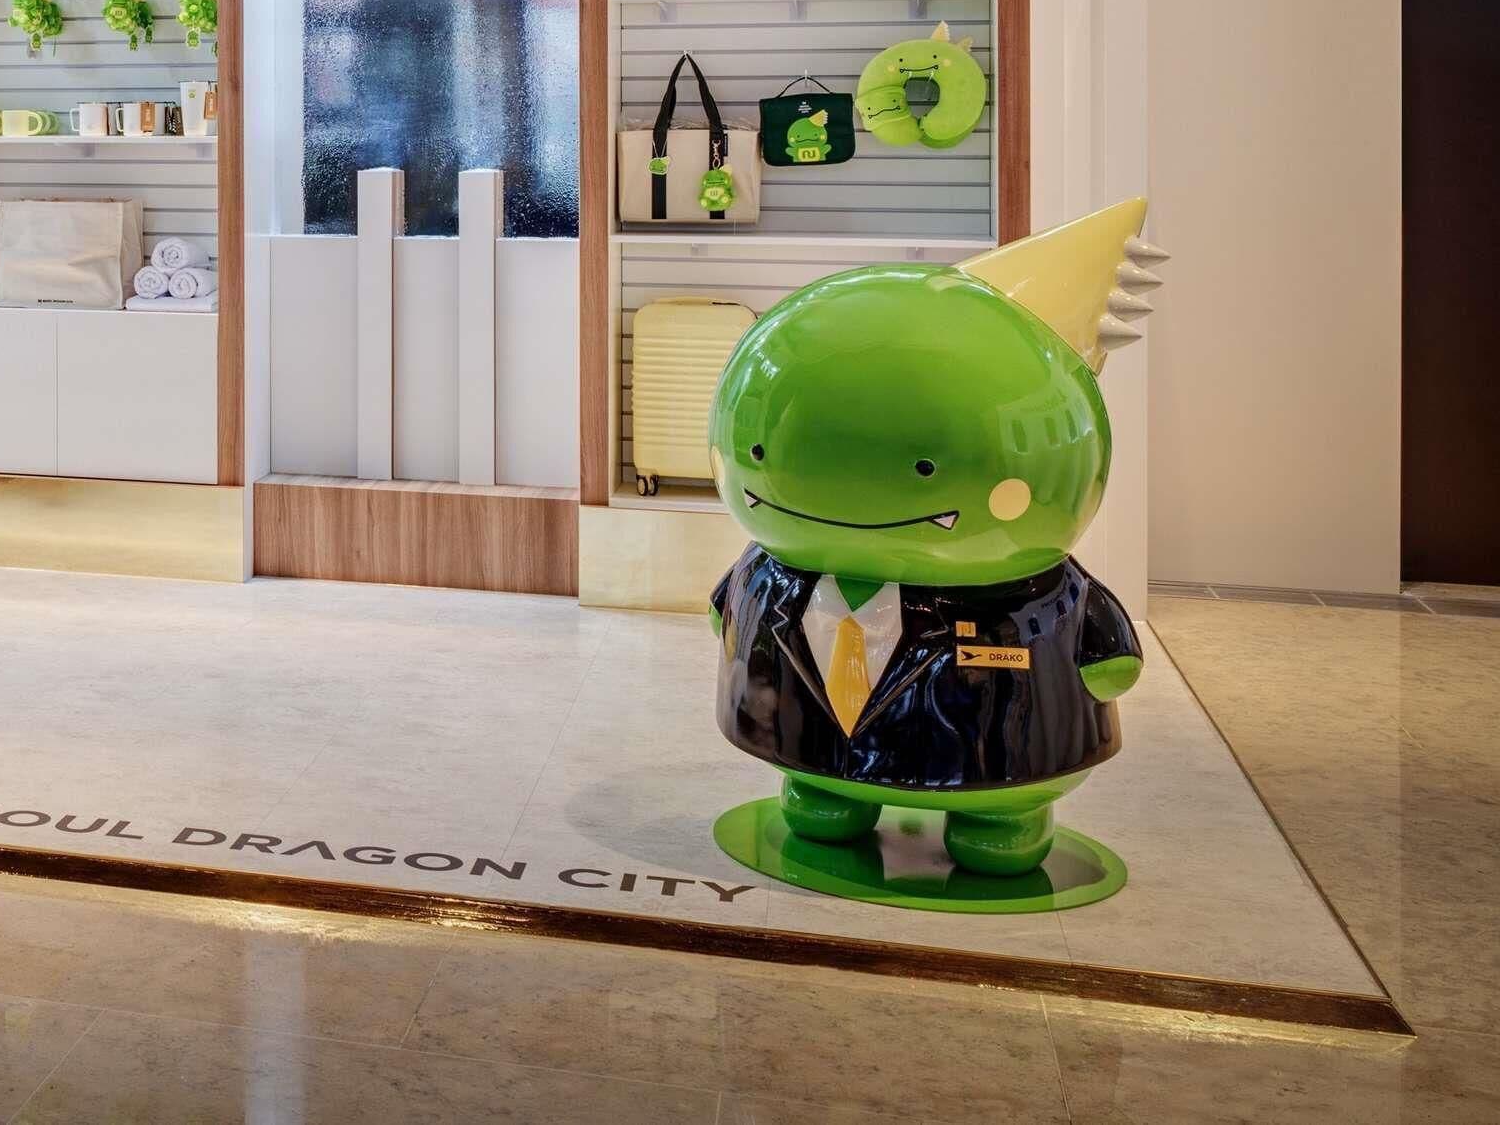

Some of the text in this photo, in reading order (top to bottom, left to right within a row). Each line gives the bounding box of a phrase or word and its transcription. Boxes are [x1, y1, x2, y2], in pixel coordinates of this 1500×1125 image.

[988, 652, 1024, 663] DRAKO
[172, 826, 527, 880] DRAGON
[558, 868, 756, 903] CITY
